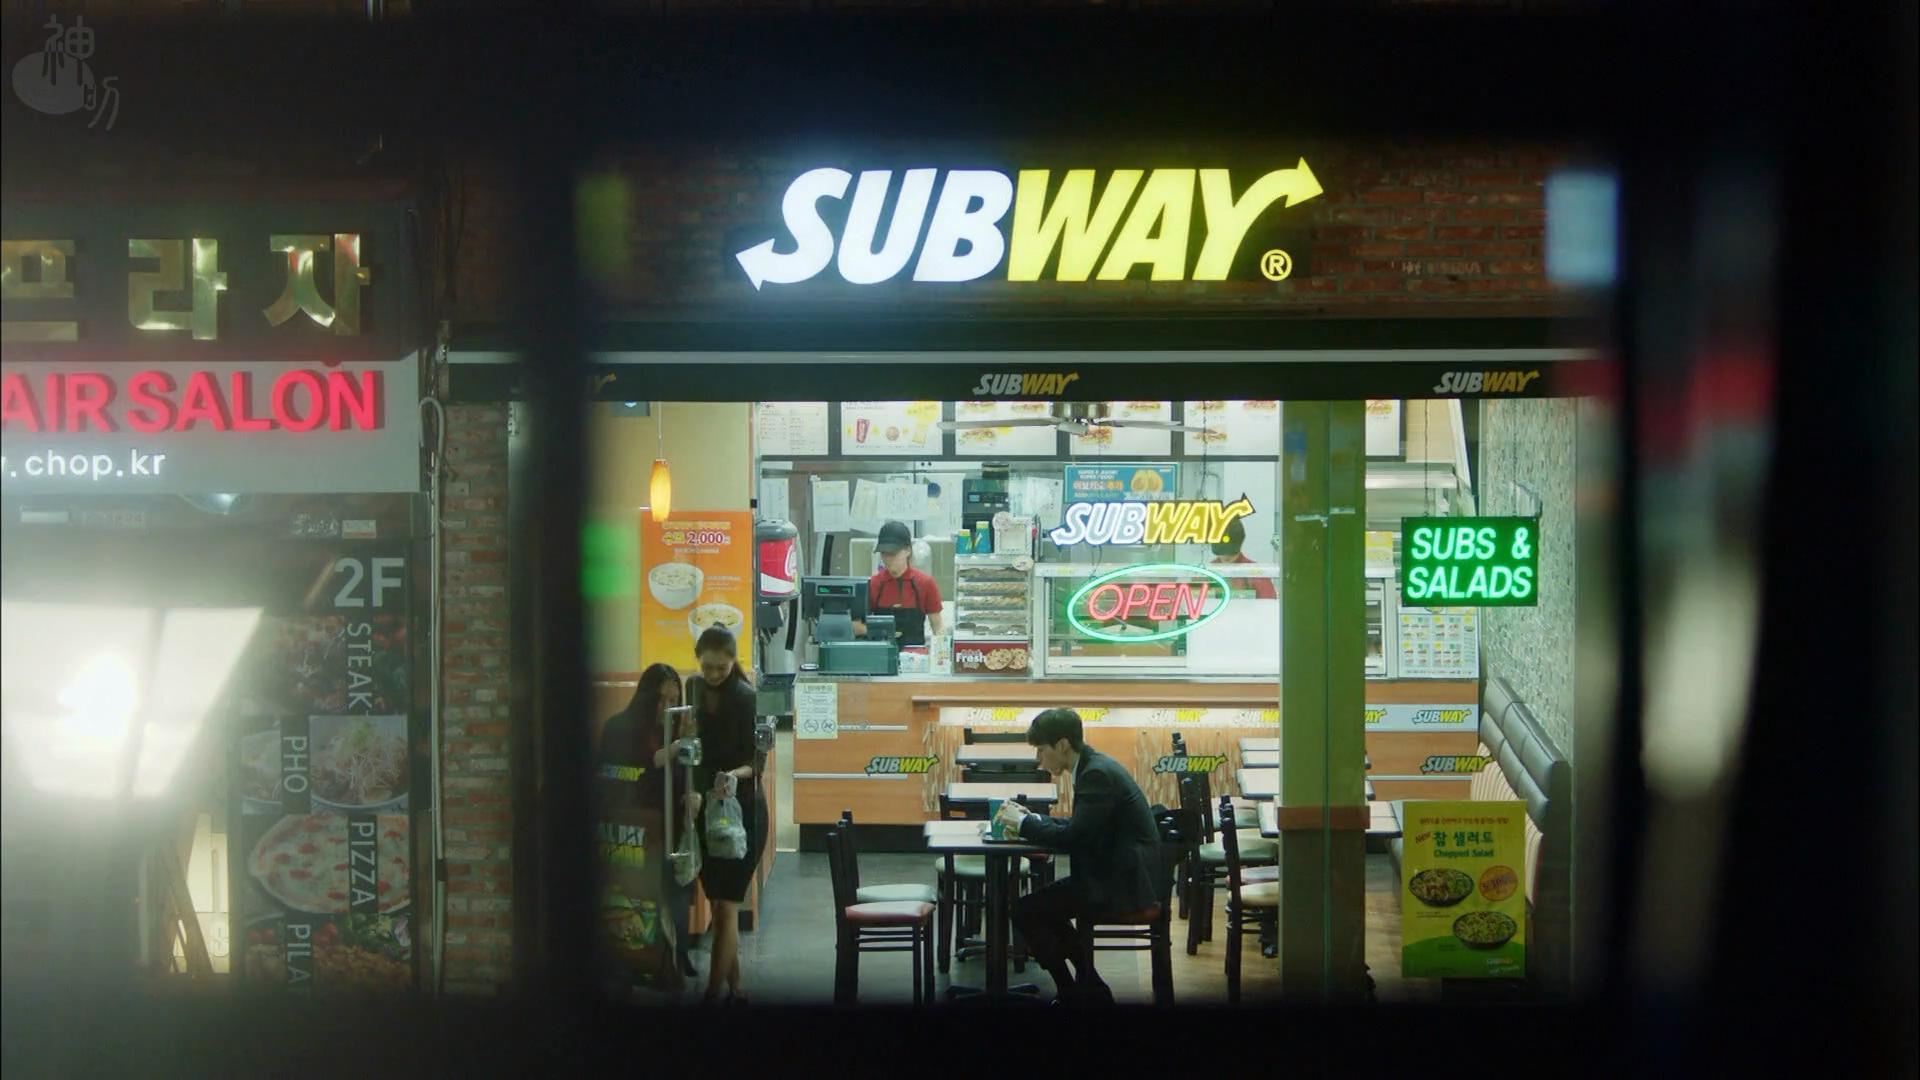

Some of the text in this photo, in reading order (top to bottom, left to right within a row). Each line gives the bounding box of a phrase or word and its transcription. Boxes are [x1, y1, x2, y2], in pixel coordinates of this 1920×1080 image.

[736, 156, 1324, 291] SUBWAY
[0, 233, 371, 341] 프라자
[126, 369, 384, 434] SALON
[972, 372, 1079, 396] SUBWAY
[1433, 370, 1540, 394] SUBWAY
[1051, 493, 1256, 546] SUBWAY
[1411, 527, 1531, 560] SUBS &
[334, 557, 405, 608] 2F
[1088, 583, 1209, 621] OPEN
[1407, 566, 1532, 599] SALADS
[347, 622, 373, 710] STEAK
[1412, 709, 1471, 724] SUBWAY
[283, 736, 308, 793] PHO
[864, 754, 939, 776] SUBWAY
[1152, 754, 1227, 774] SUBWAY
[1420, 754, 1494, 774] SUBWAY
[351, 821, 376, 906] PIZZA
[286, 924, 311, 992] PILA
